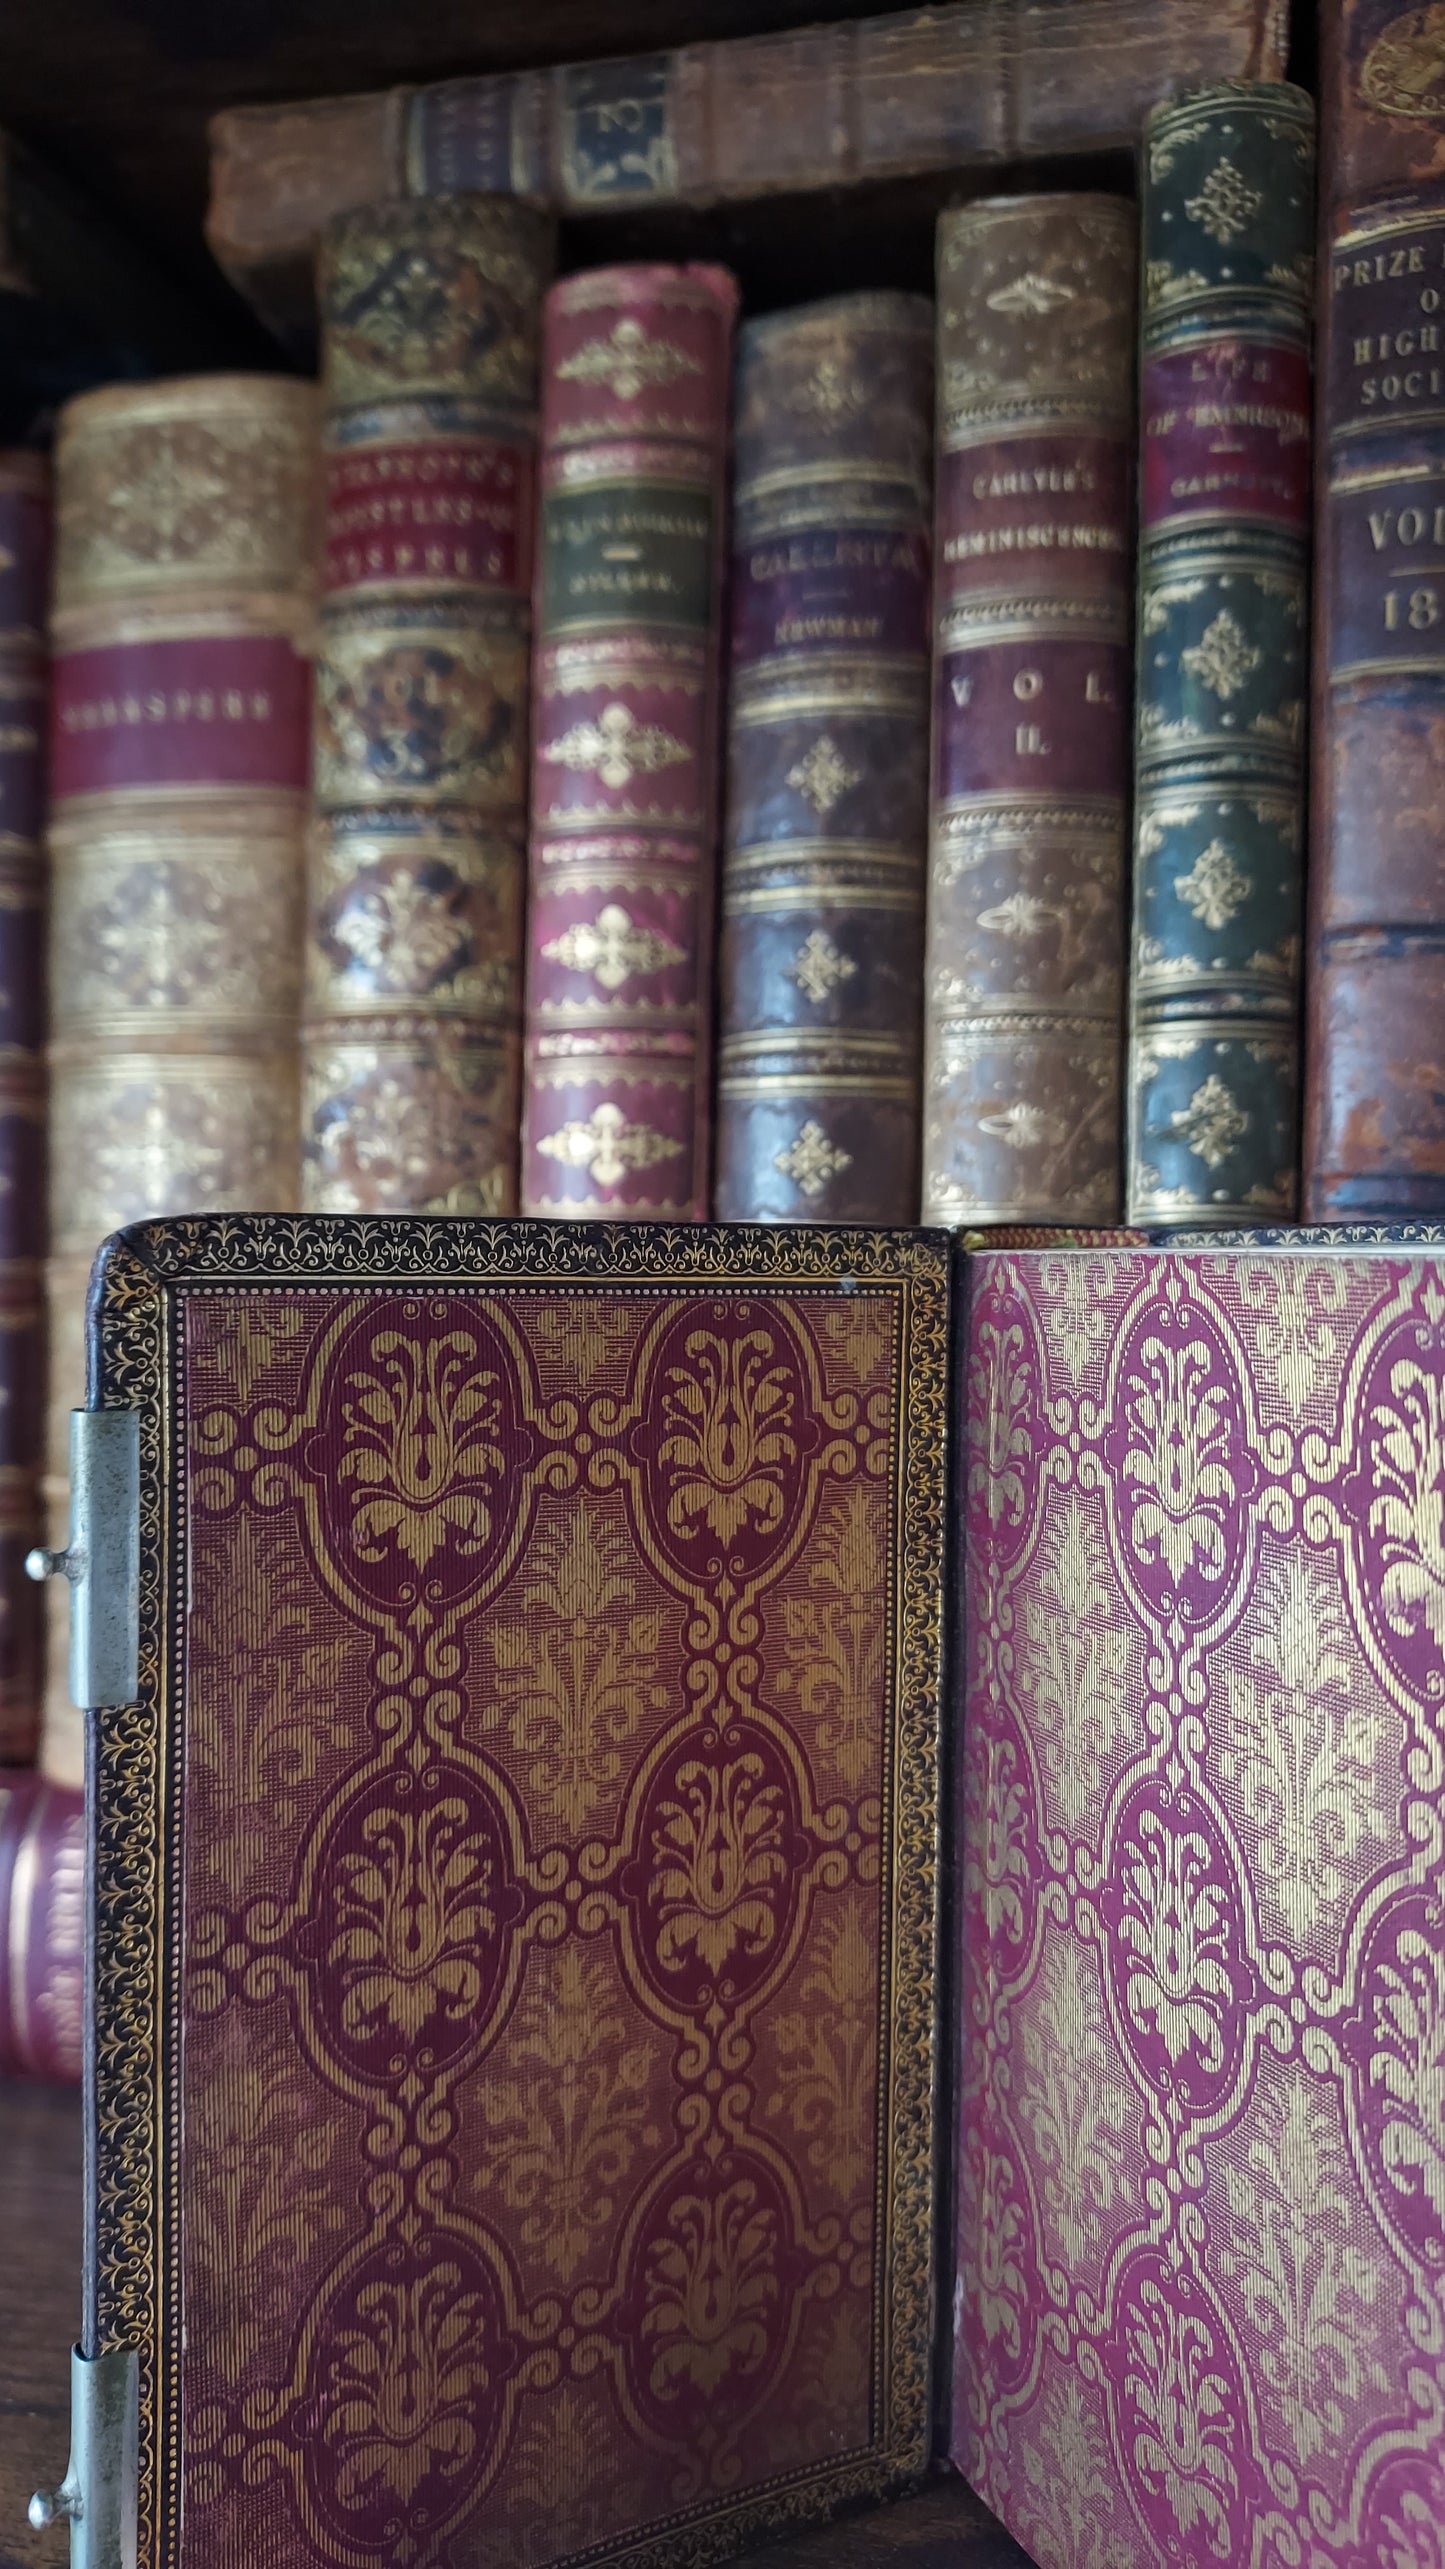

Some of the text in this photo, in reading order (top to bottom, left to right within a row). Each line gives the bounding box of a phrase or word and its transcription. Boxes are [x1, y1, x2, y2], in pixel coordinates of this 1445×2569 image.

[1334, 246, 1425, 291] PRIZE
[1353, 325, 1438, 366] HIGH
[1360, 367, 1440, 405] SOCI
[972, 458, 1096, 500] CARLYLE'S
[1384, 587, 1438, 631] 18
